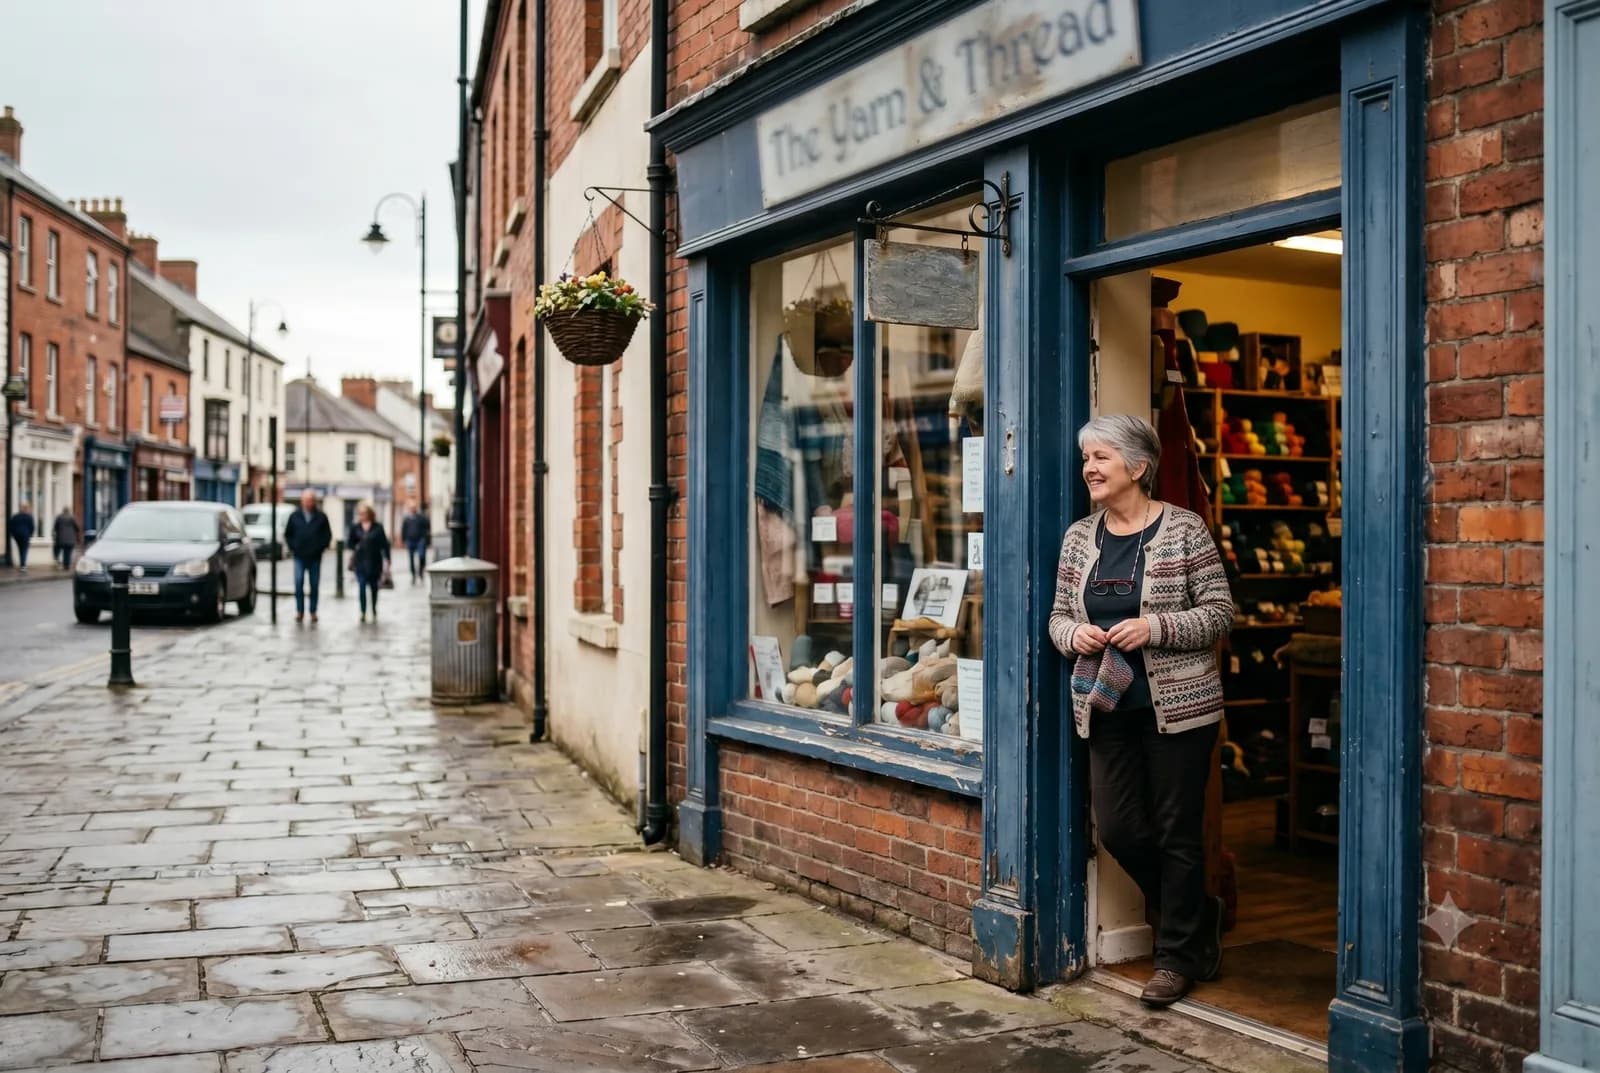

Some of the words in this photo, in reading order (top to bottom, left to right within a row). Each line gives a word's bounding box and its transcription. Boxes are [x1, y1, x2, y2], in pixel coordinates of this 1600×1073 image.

[769, 123, 821, 177] The
[828, 89, 905, 163] Yarn
[918, 56, 947, 114] &
[956, 0, 1115, 95] Thread
